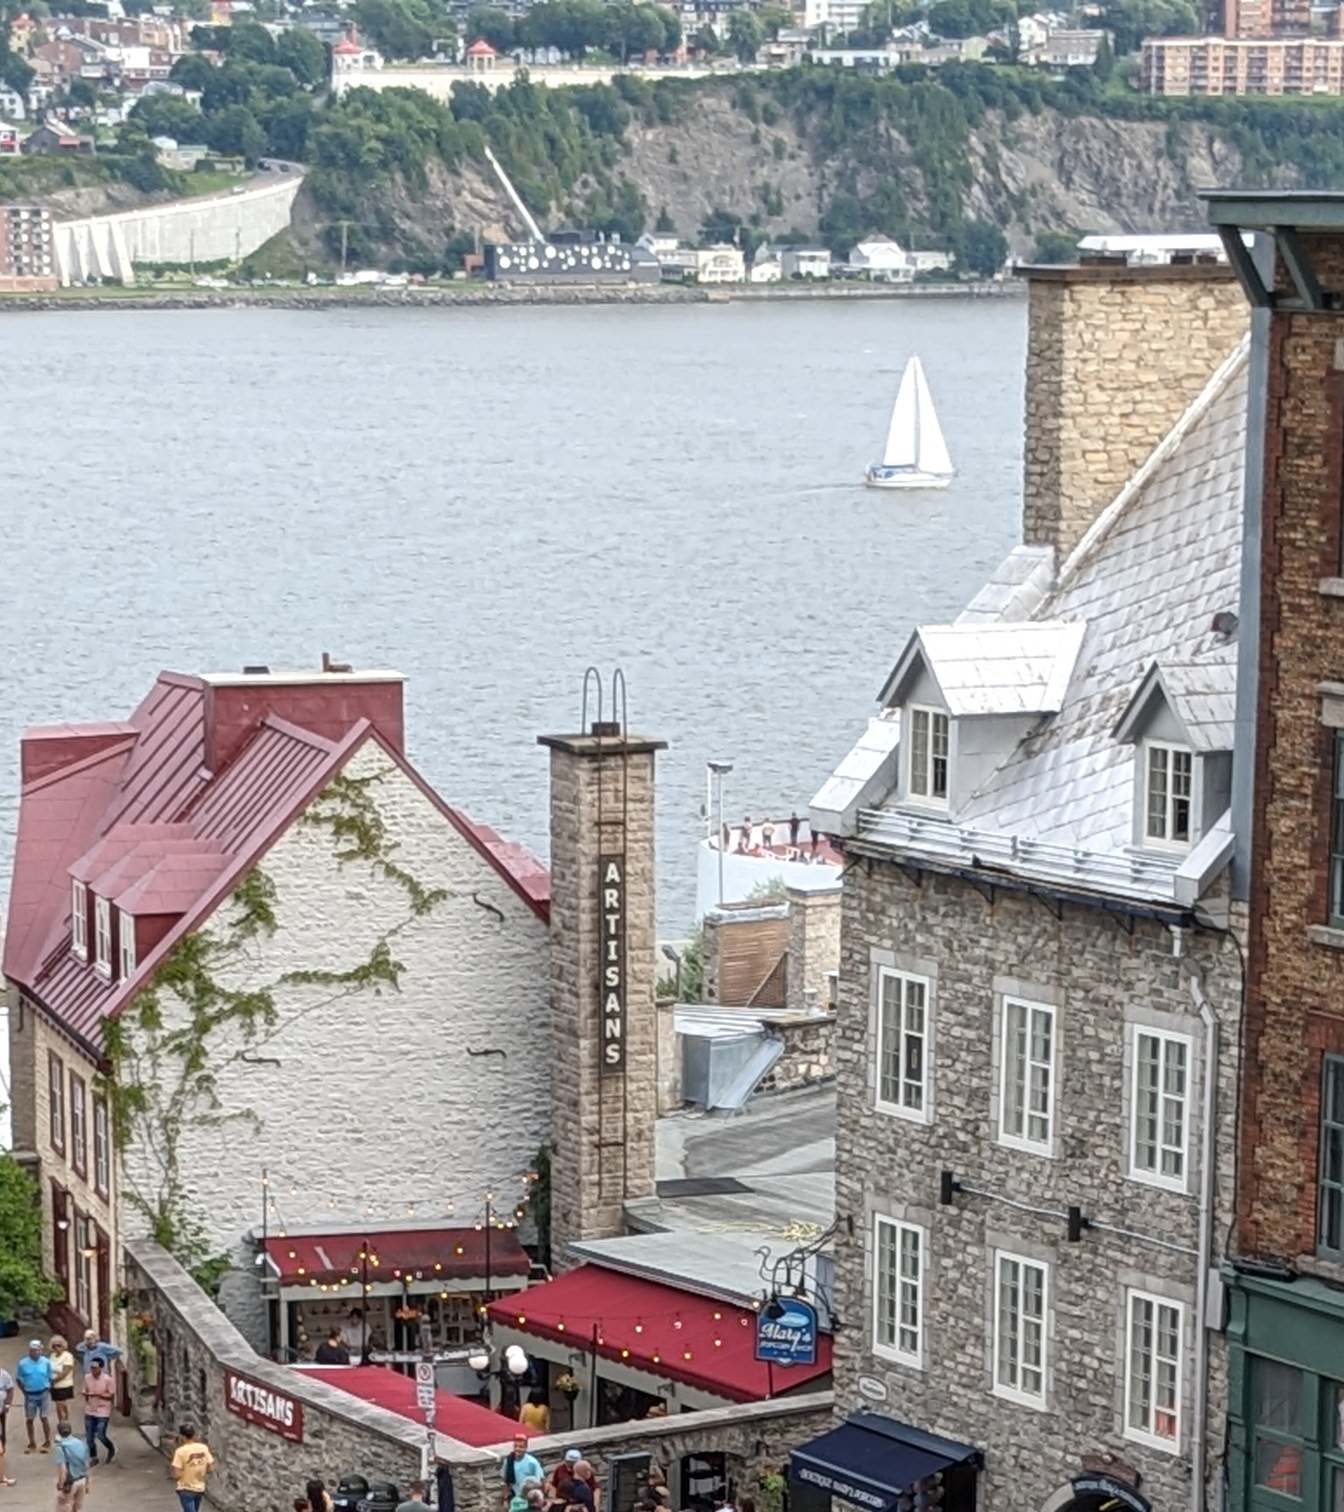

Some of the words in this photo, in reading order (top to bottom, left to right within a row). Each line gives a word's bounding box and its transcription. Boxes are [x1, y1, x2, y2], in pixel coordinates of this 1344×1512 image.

[604, 862, 621, 1065] ARTISANS
[759, 1323, 812, 1352] Mary's
[230, 1376, 294, 1427] ARTISANS
